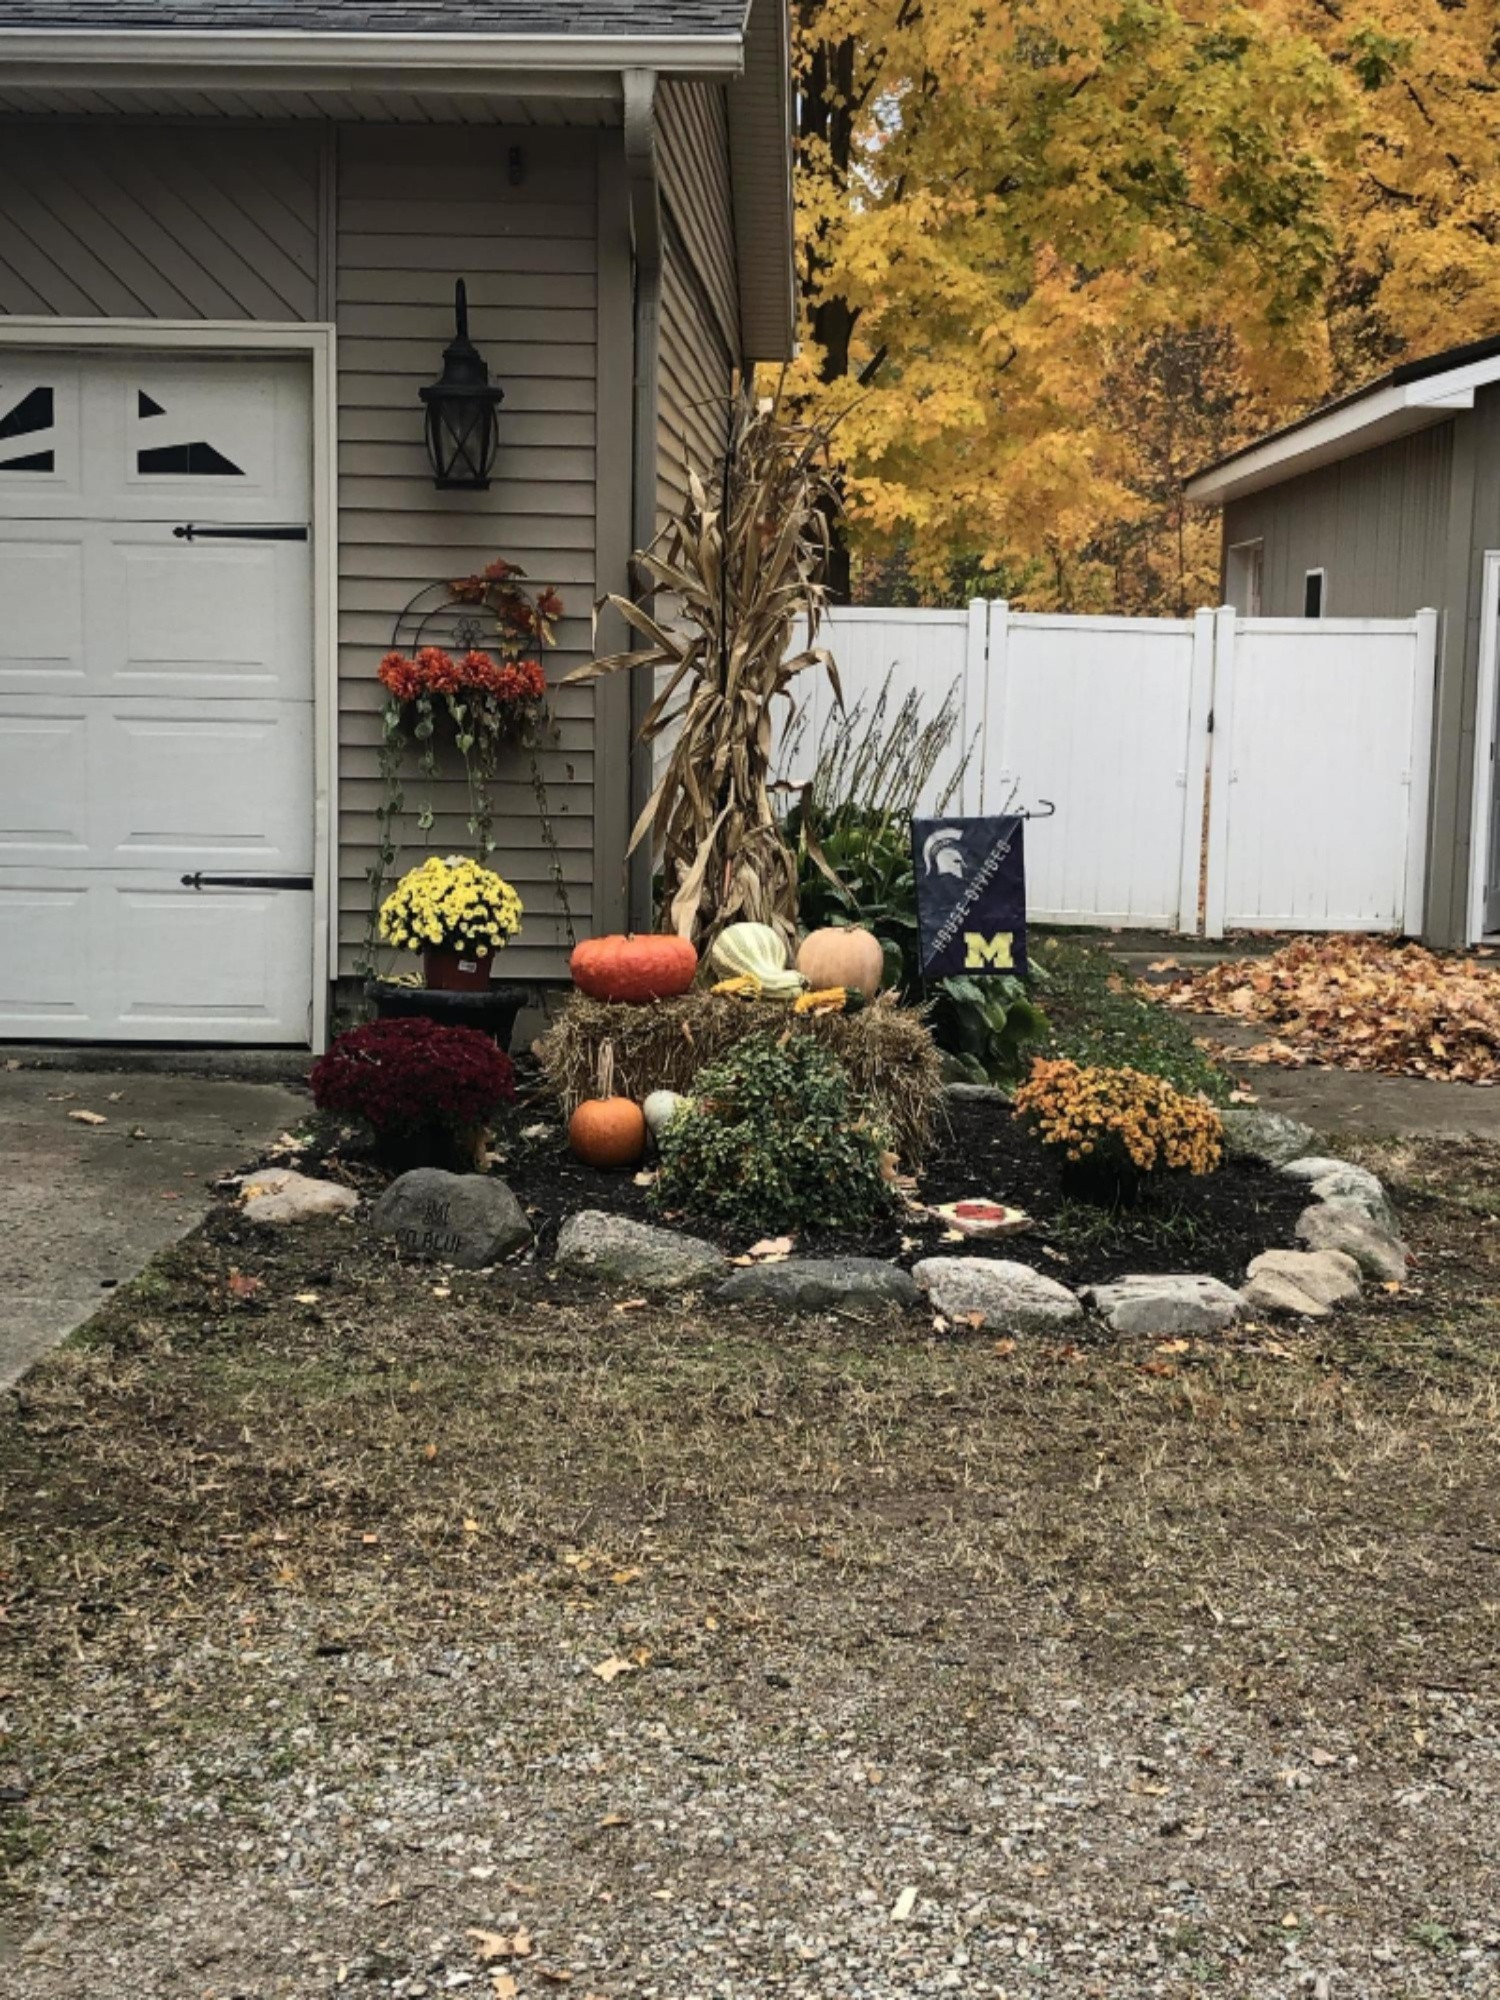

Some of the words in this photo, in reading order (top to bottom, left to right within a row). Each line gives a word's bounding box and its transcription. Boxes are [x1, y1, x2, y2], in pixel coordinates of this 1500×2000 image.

[931, 902, 971, 953] HOUSE
[964, 839, 1012, 901] DIVIDED
[963, 932, 1015, 968] M
